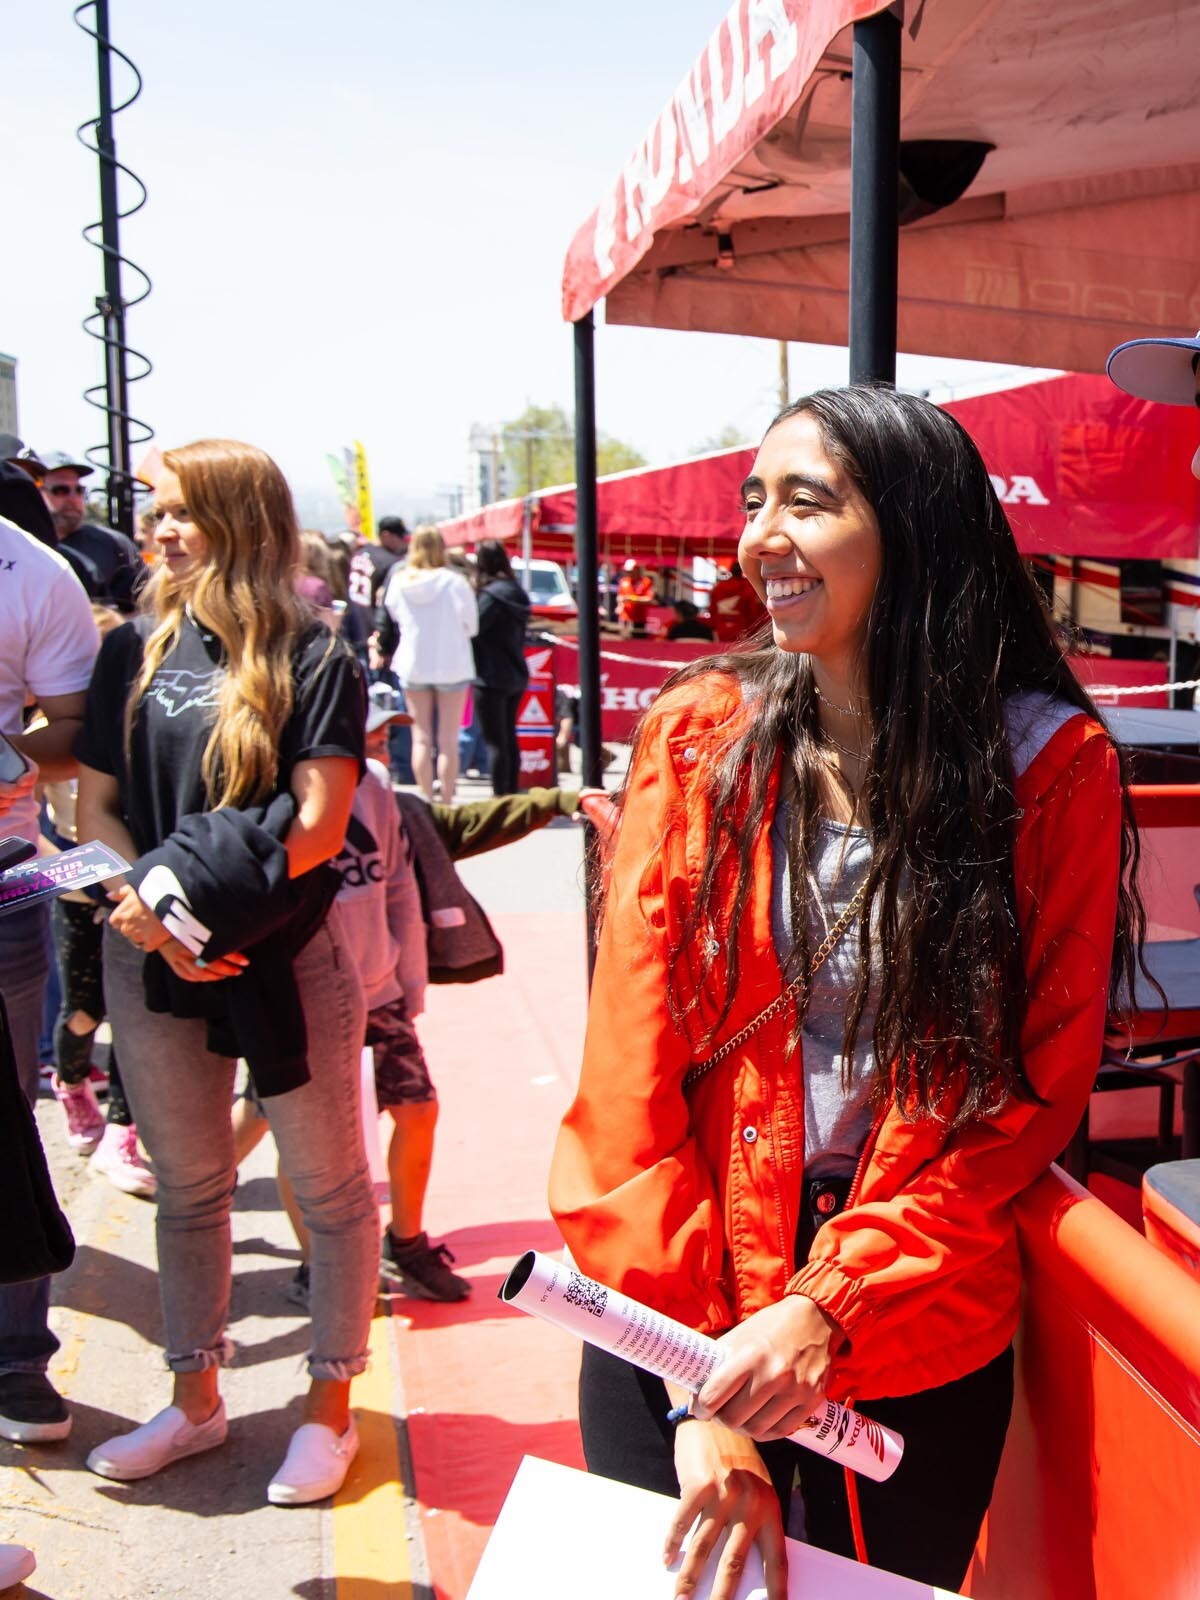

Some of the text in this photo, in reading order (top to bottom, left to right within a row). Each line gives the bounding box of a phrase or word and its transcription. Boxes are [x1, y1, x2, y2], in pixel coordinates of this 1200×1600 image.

[655, 1328, 676, 1364] 2022 model
[680, 1343, 692, 1360] Team
[815, 1404, 836, 1441] EDITION
